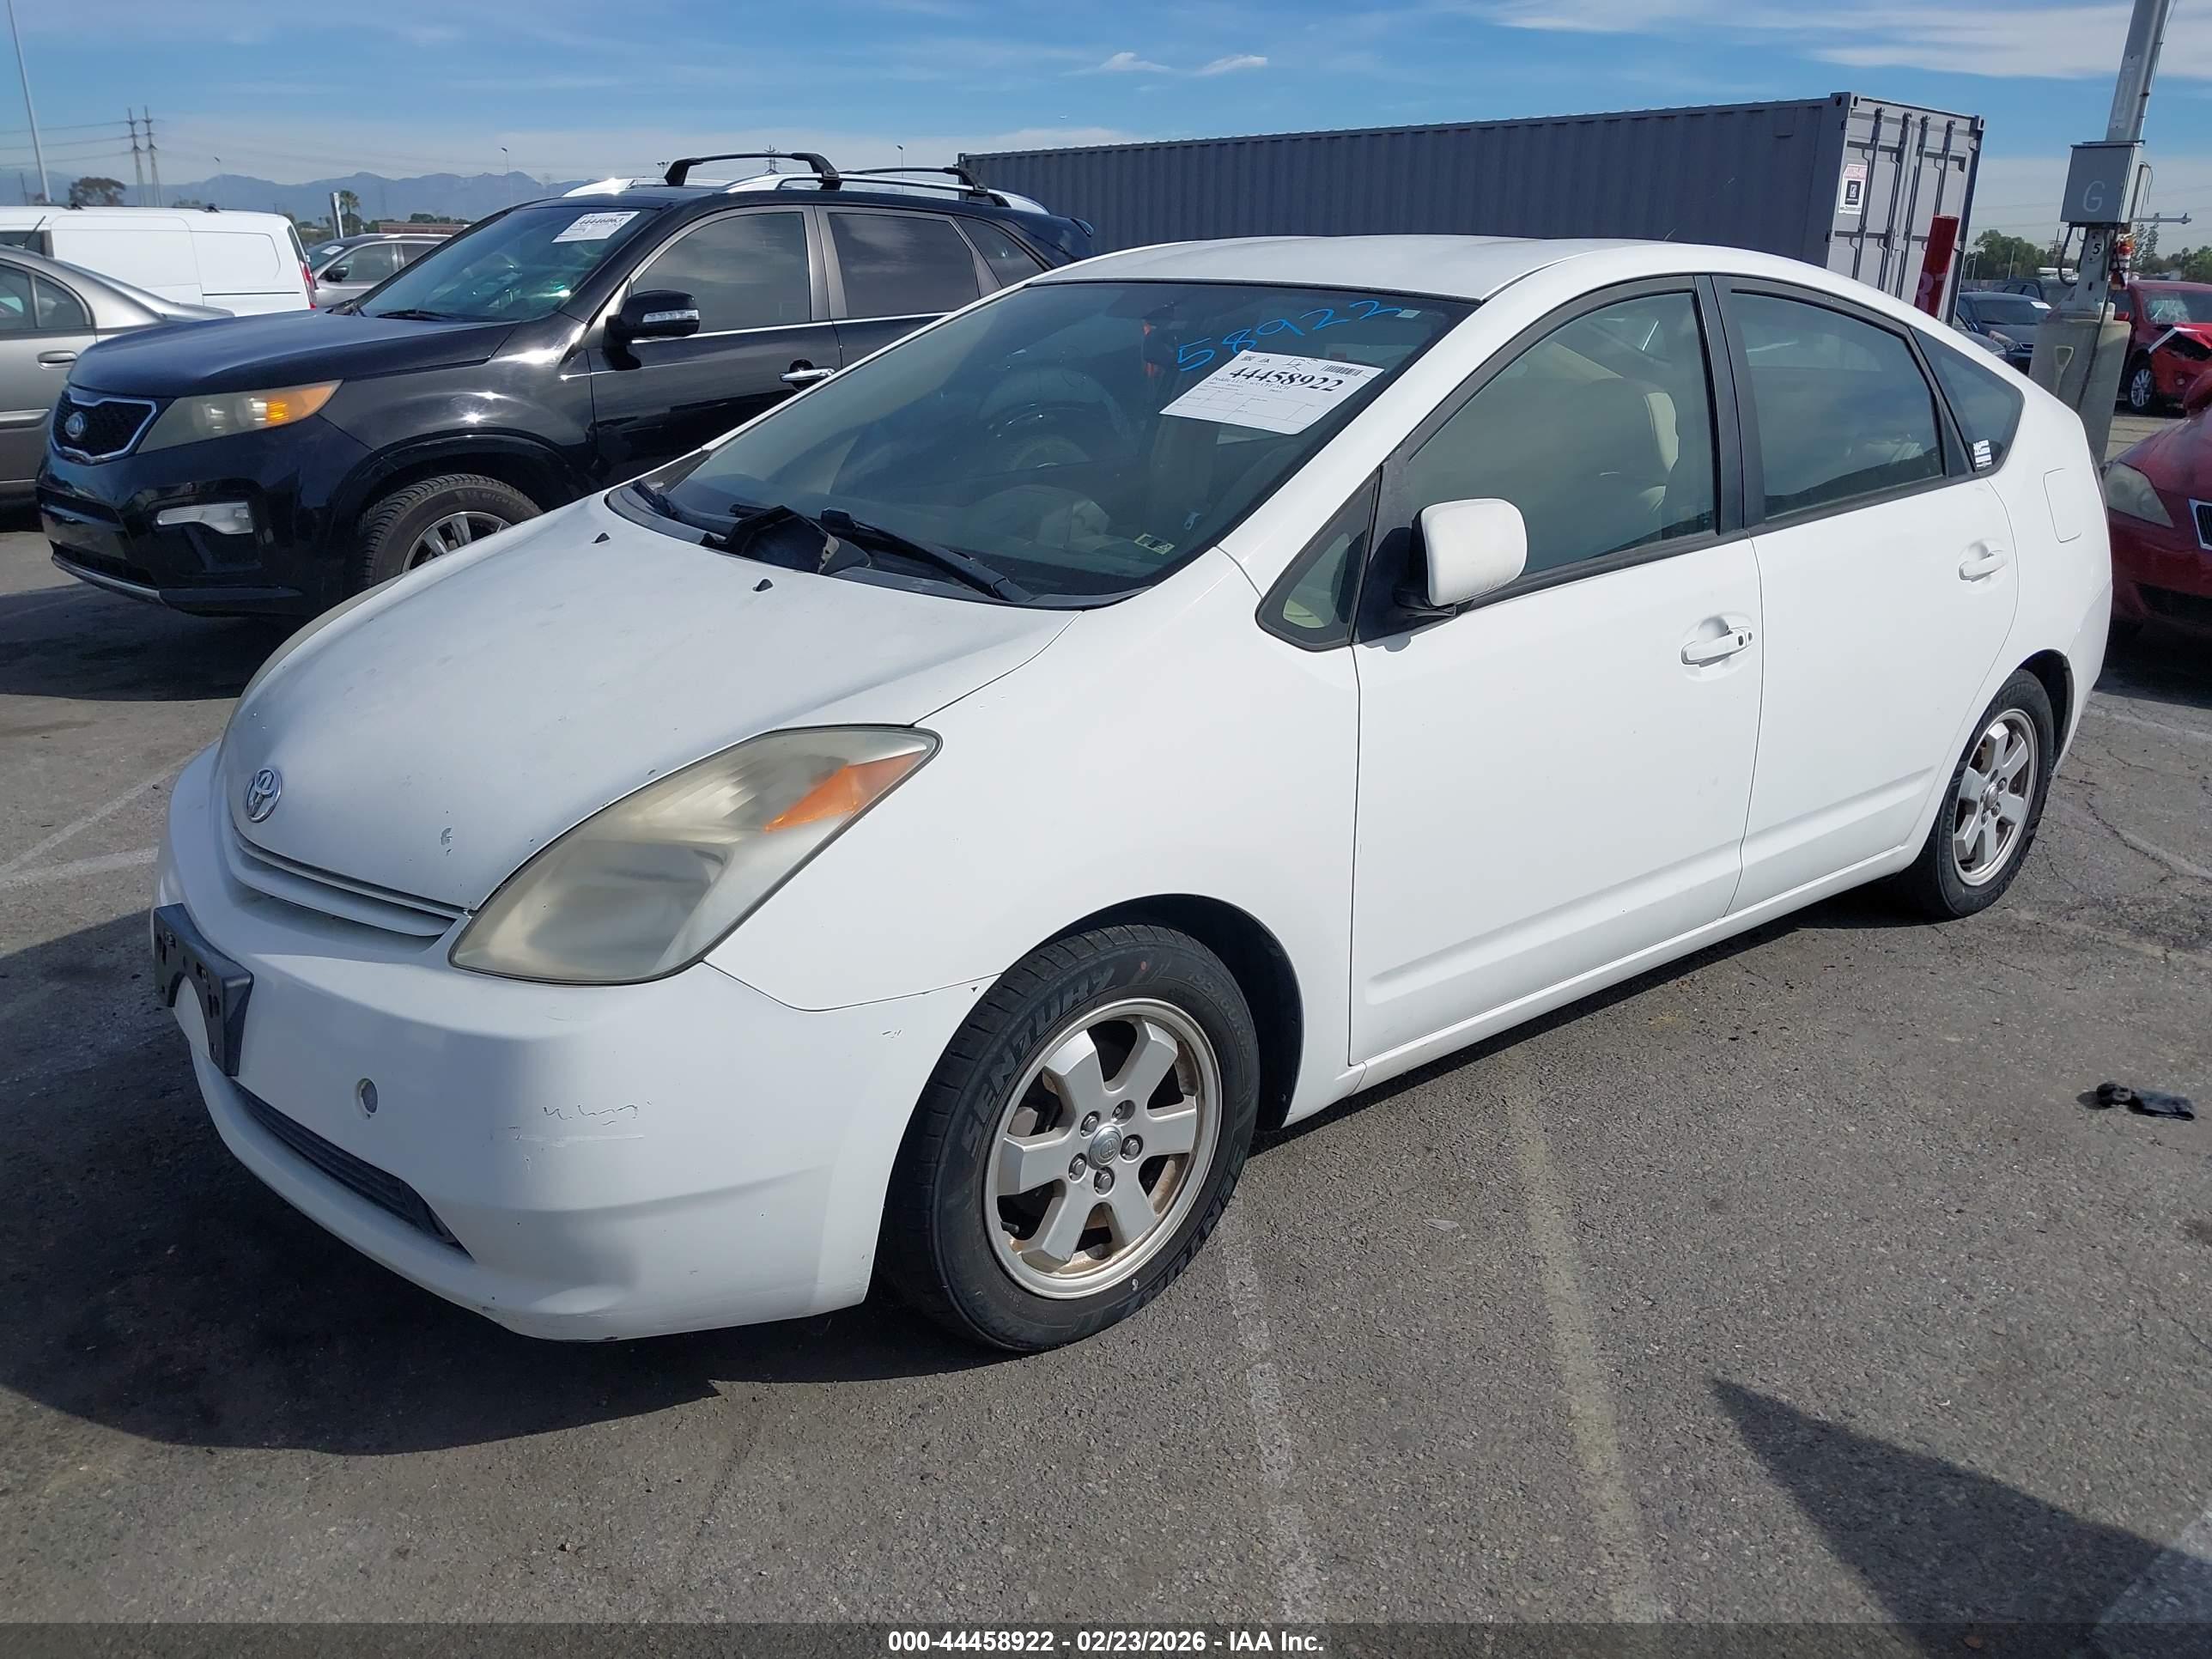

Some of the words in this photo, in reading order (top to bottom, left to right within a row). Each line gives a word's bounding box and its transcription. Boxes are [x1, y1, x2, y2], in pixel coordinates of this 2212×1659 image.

[2082, 180, 2106, 213] G
[2092, 243, 2101, 255] 5
[1228, 367, 1345, 392] 44458922
